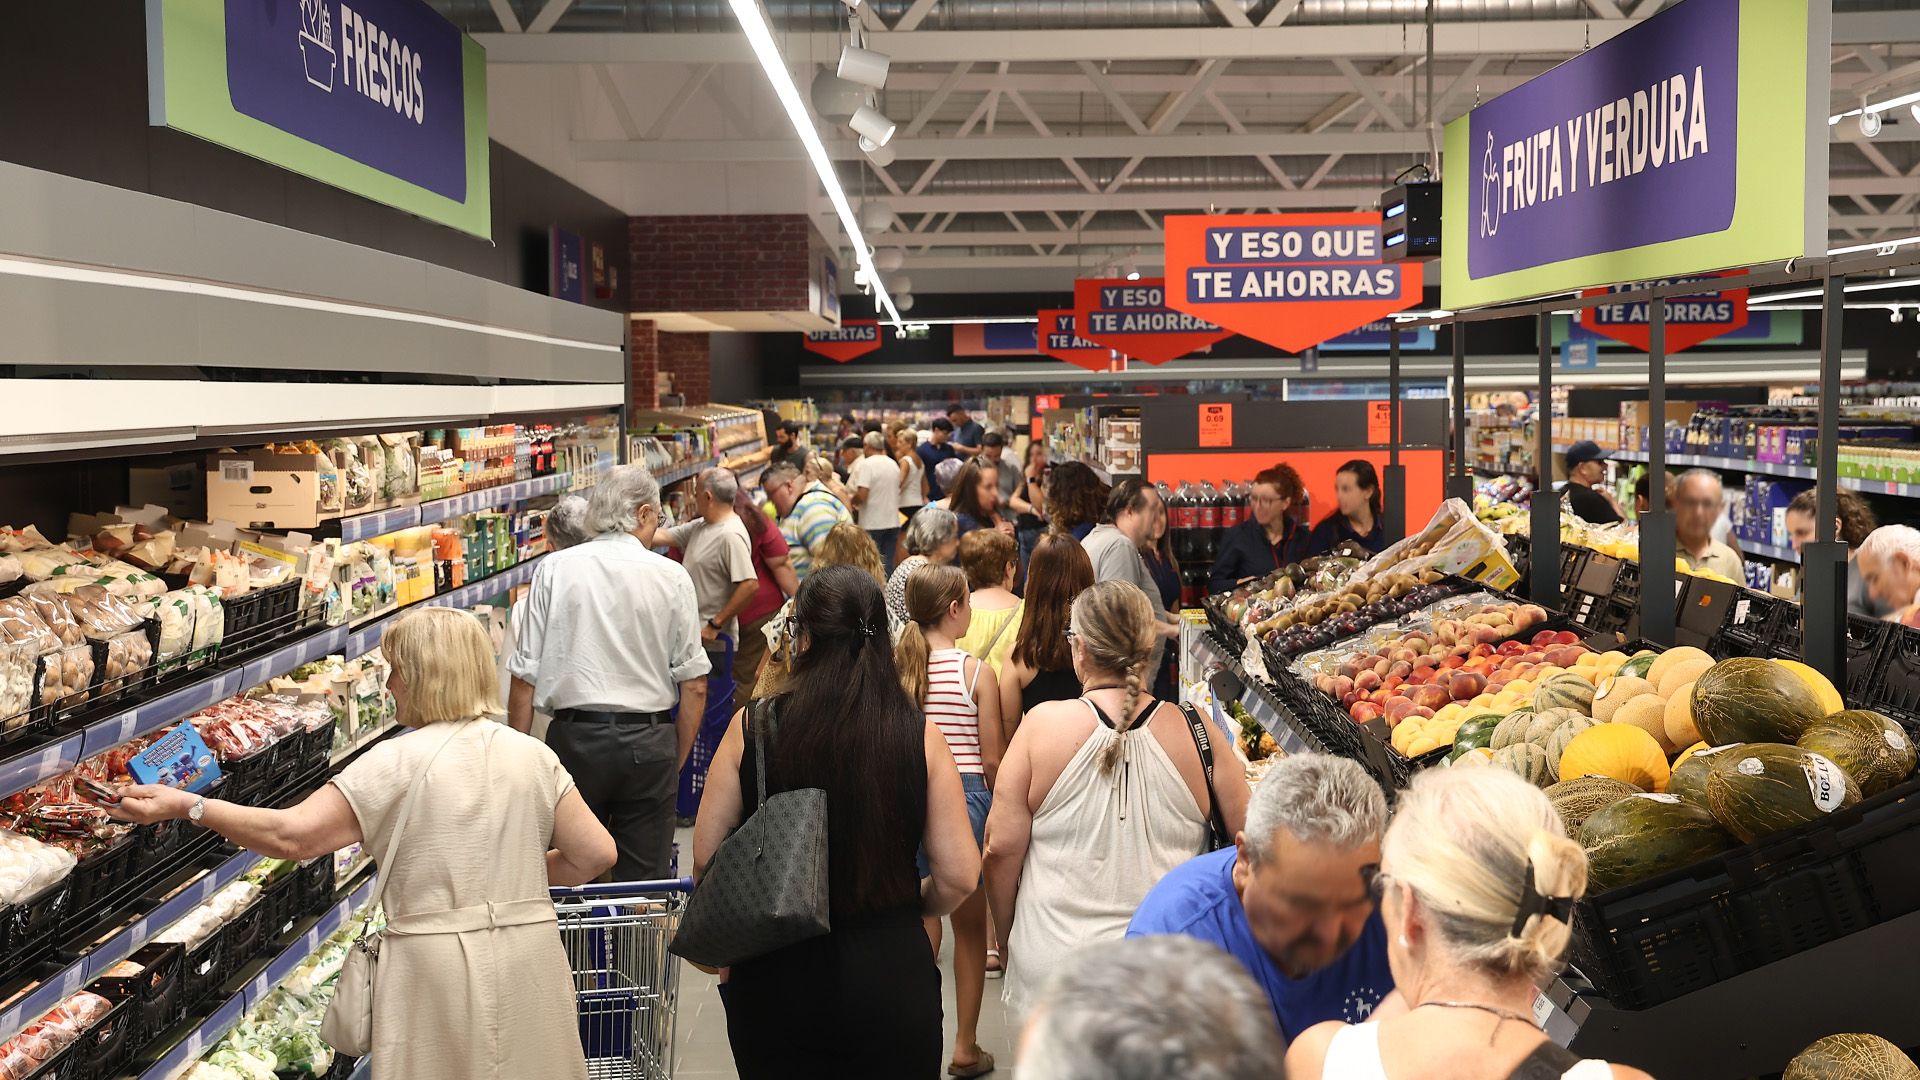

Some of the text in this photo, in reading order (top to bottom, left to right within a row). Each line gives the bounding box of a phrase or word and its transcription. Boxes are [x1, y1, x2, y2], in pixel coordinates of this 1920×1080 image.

[341, 3, 424, 125] FRESCOS
[1503, 65, 1709, 215] FRUTA Y VERDURA
[1212, 229, 1376, 259] Y ESO QUE
[1192, 268, 1395, 298] TE AHORRAS
[1104, 288, 1162, 307] Y ESO
[1059, 317, 1068, 330] Y
[1092, 314, 1117, 332] TE
[1599, 304, 1625, 322] TE
[810, 327, 876, 341] OFERTAS
[1050, 335, 1069, 348] TE
[1194, 722, 1210, 751] PUMA
[1814, 757, 1831, 802] BOLLO
